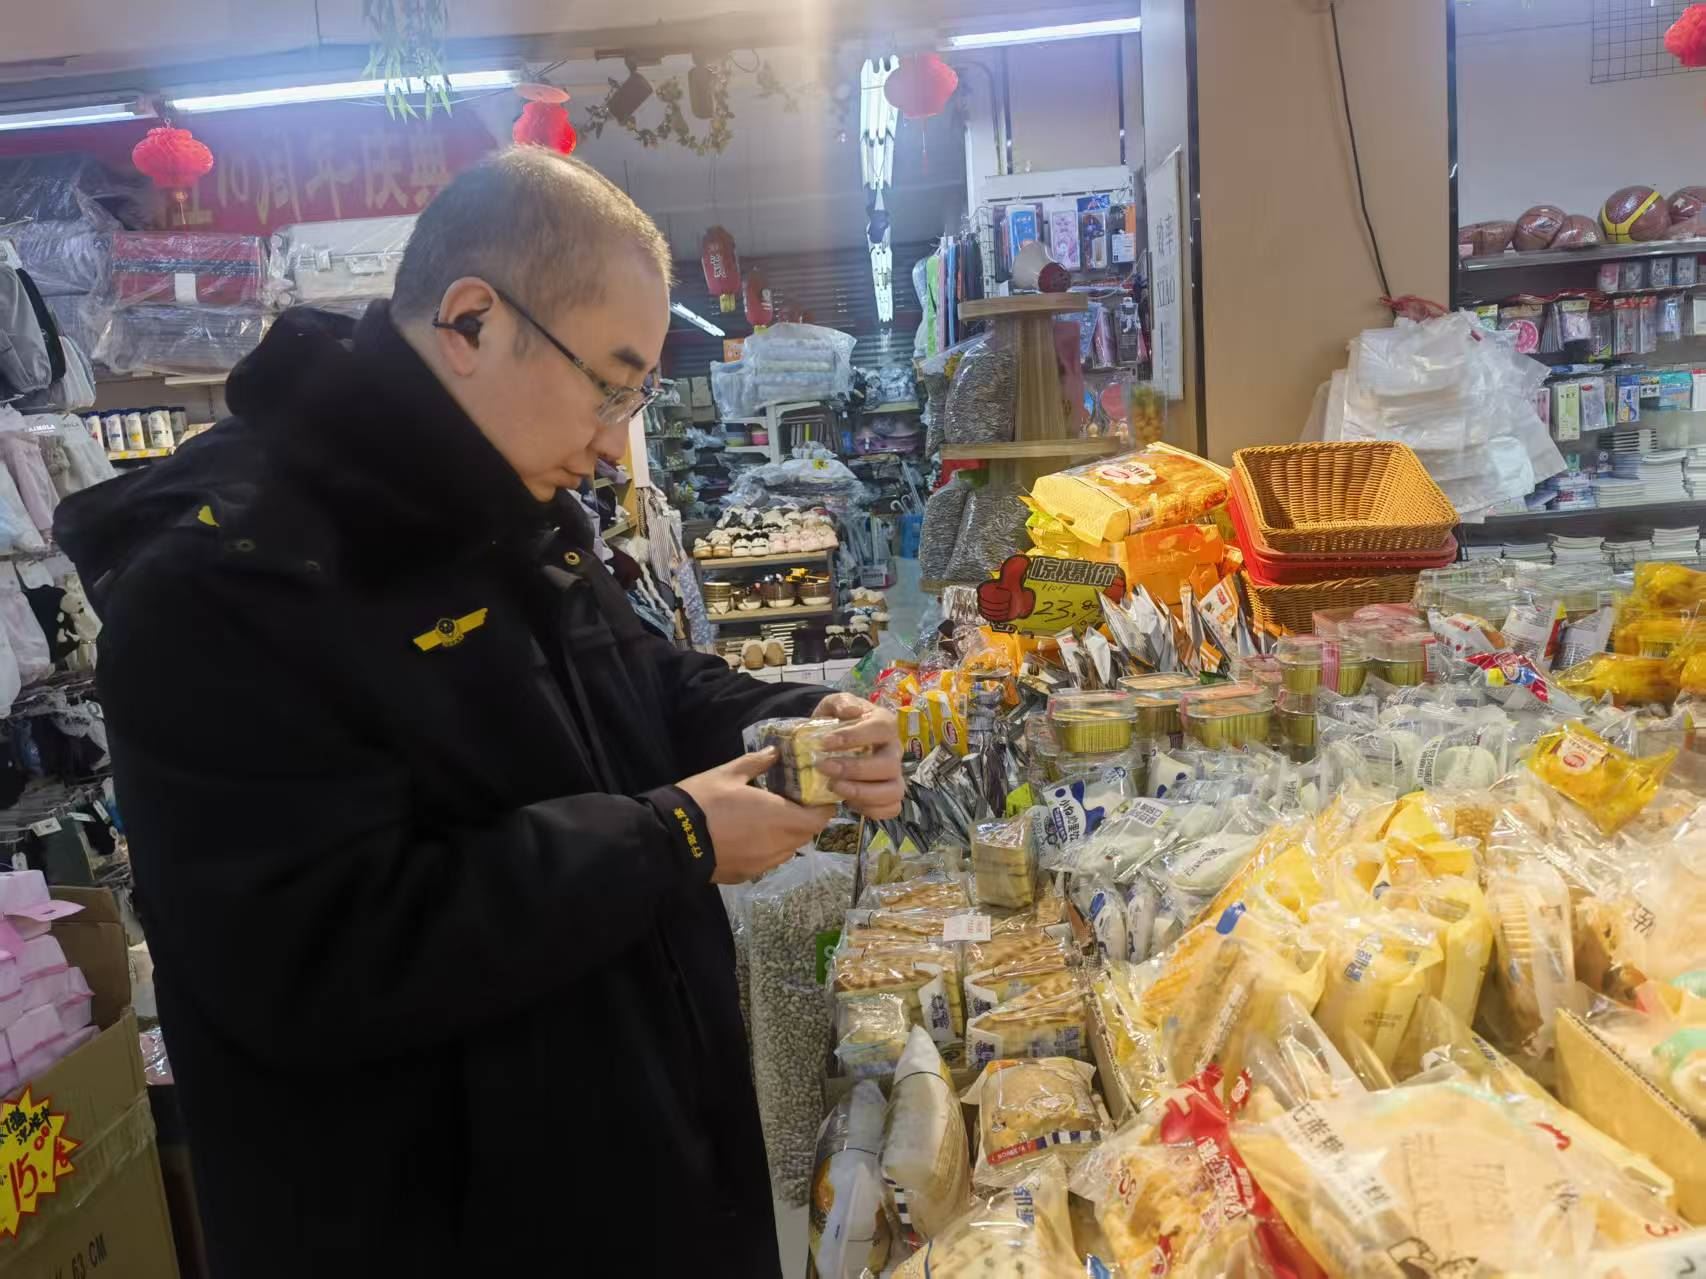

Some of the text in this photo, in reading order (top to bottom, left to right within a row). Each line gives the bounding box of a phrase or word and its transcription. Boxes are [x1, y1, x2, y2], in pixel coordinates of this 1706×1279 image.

[1029, 557, 1118, 586] 惊爆价
[88, 1233, 108, 1268] CM
